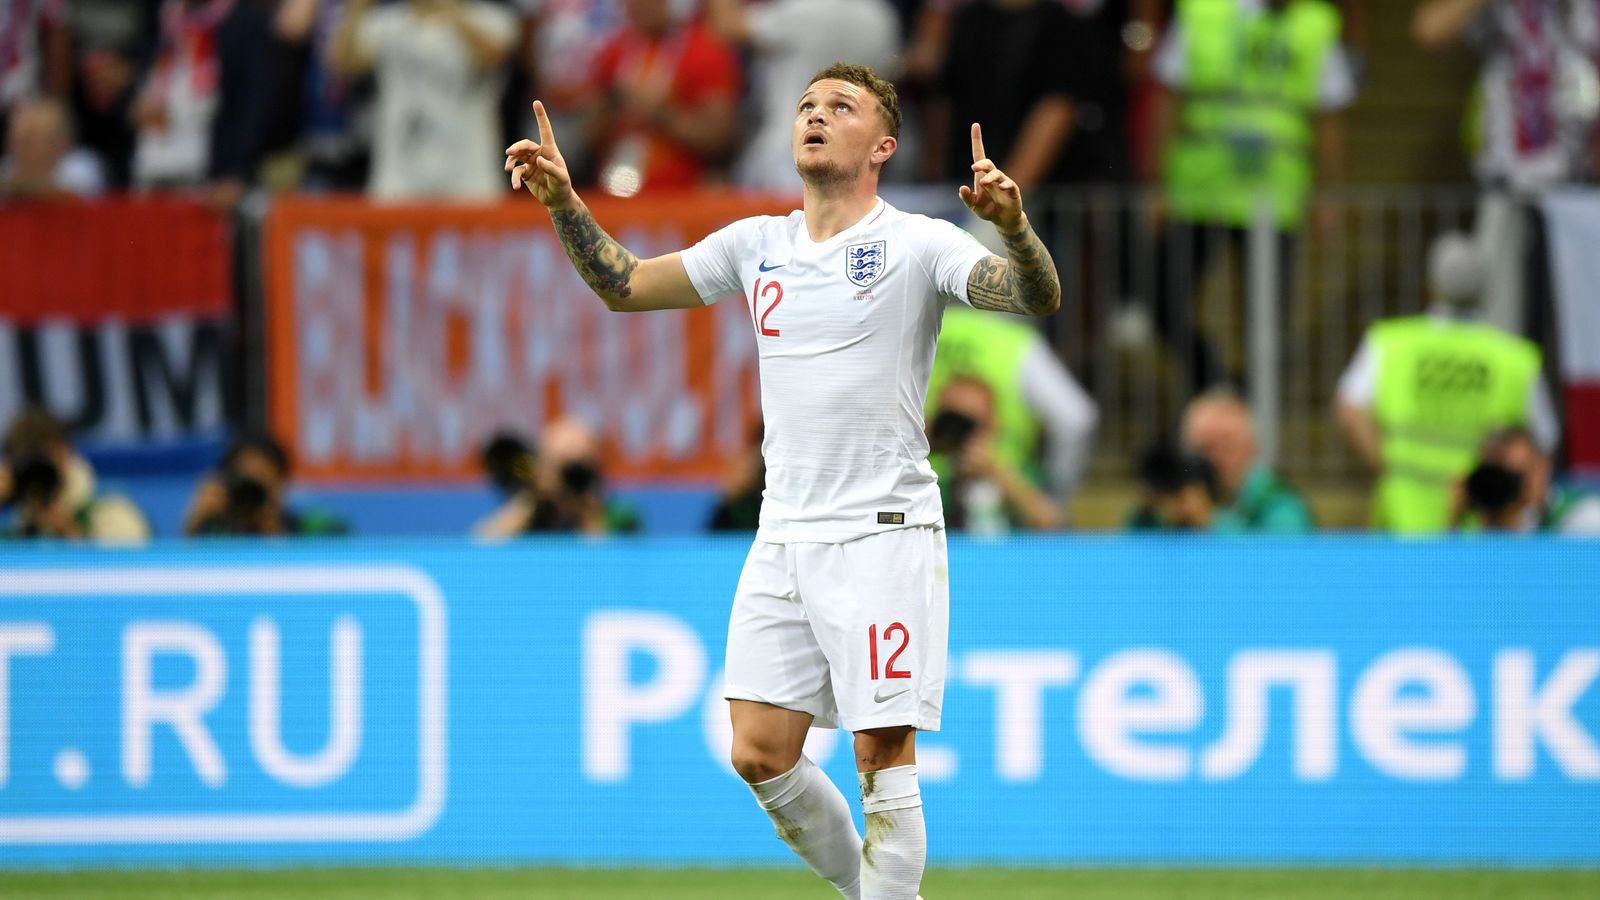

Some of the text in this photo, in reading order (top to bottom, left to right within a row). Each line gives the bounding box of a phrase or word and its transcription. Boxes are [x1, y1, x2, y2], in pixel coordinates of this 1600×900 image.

[753, 278, 784, 337] 12
[869, 622, 911, 680] 12
[579, 609, 1600, 784] Ртелек
